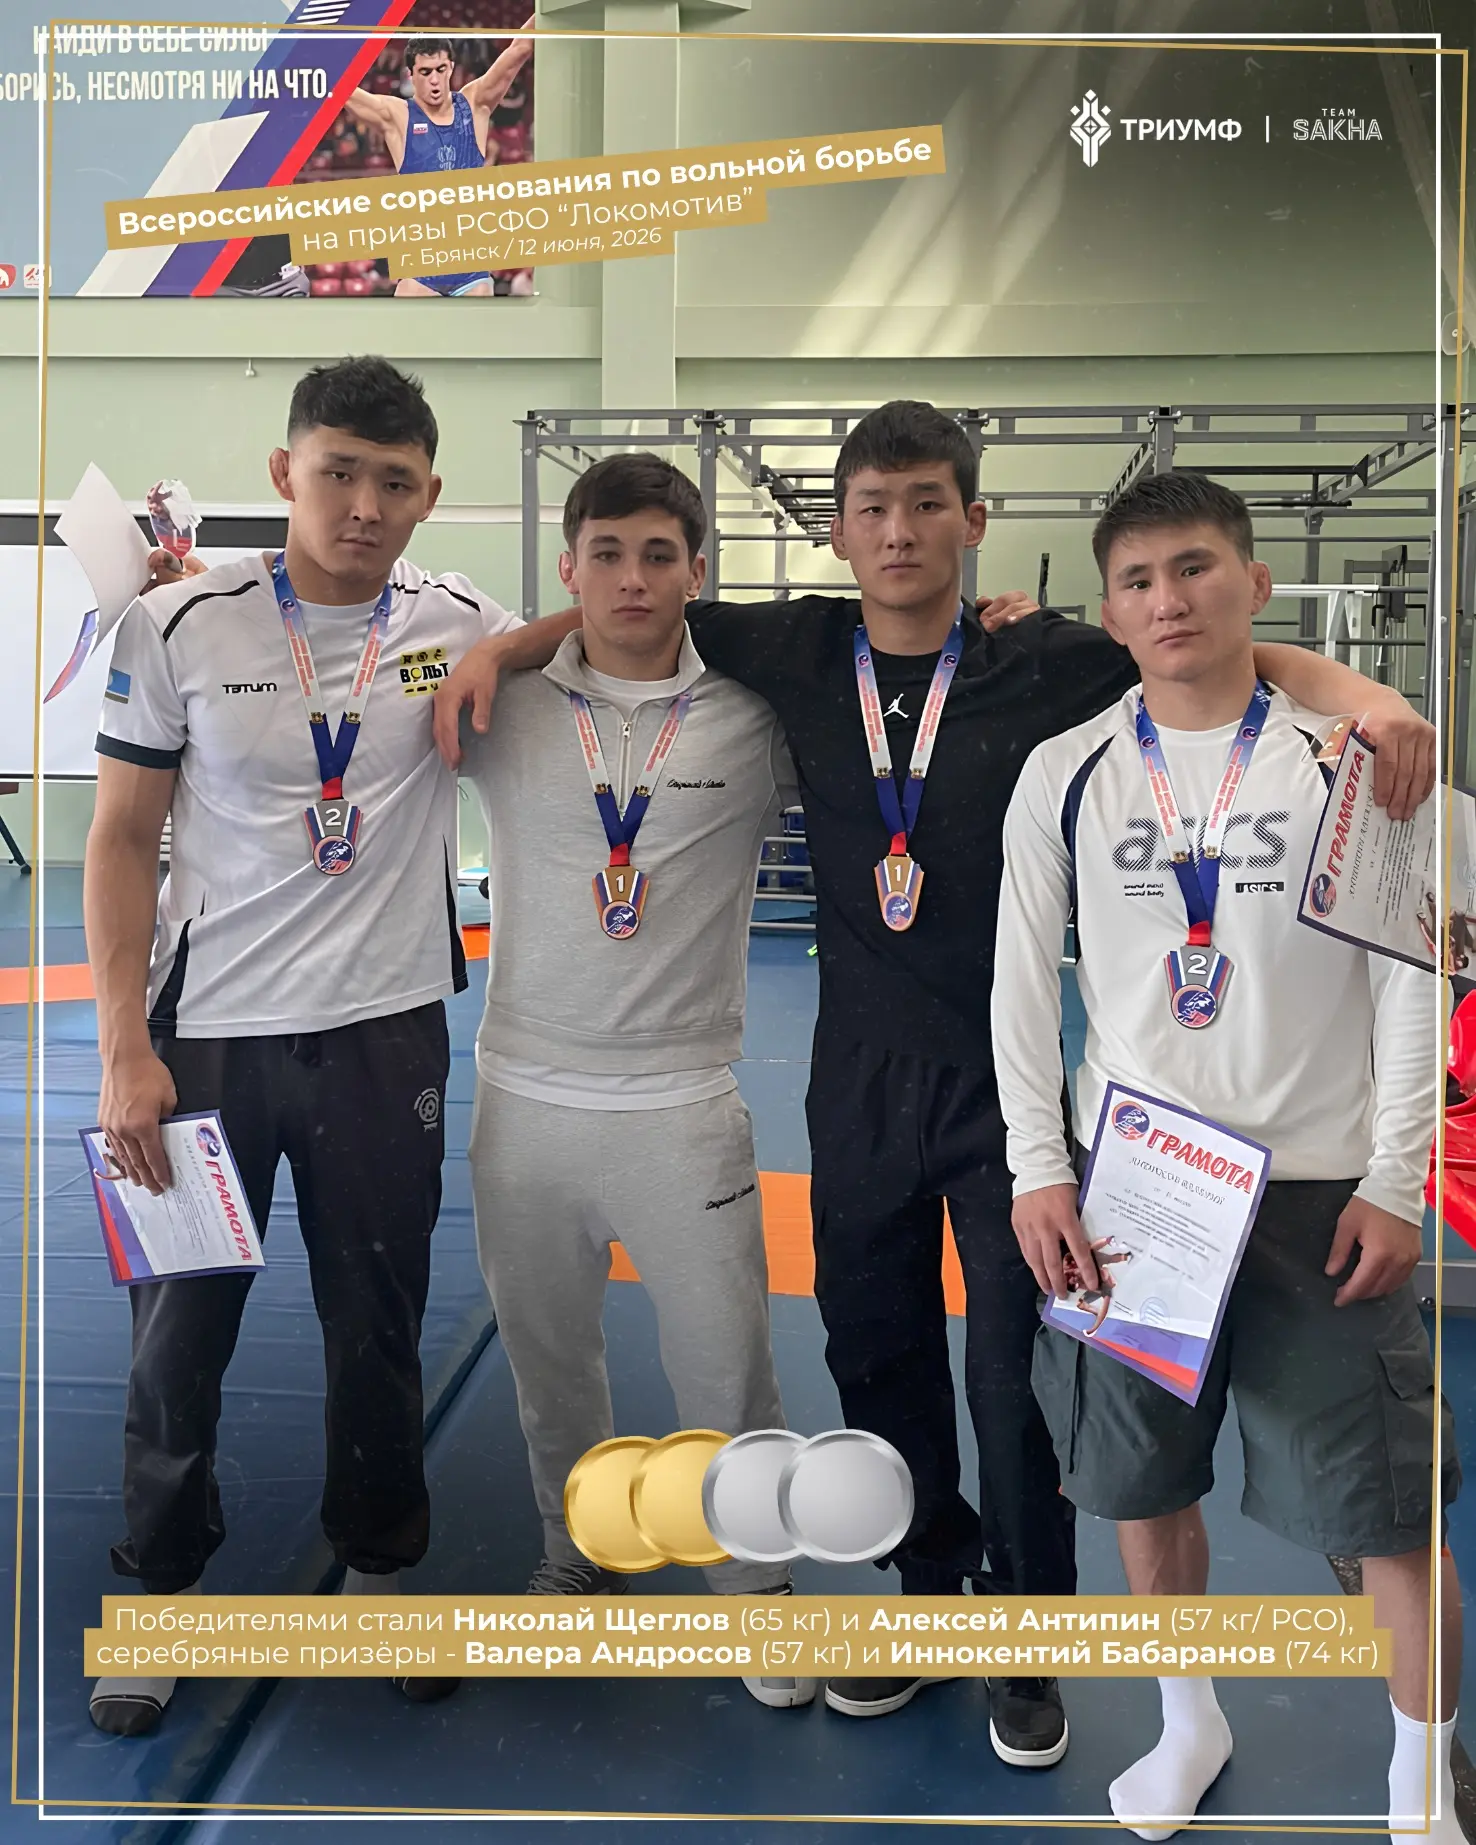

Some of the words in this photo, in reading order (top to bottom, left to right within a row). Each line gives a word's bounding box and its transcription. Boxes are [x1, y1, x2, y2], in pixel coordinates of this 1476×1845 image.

[118, 25, 132, 53] В
[138, 25, 193, 53] СЕБЕ
[87, 70, 205, 101] НЕСМОТРЯ
[212, 70, 244, 100] НИ
[250, 69, 280, 99] НА
[284, 67, 334, 99] ЧТО.
[325, 808, 342, 827] 2
[1326, 749, 1366, 878] ГРАМОТА
[615, 874, 626, 894] 1
[893, 864, 903, 882] 1
[1187, 953, 1208, 976] 2
[1146, 1128, 1255, 1194] ГРАМОТА
[204, 1159, 252, 1261] ГРАМОТА
